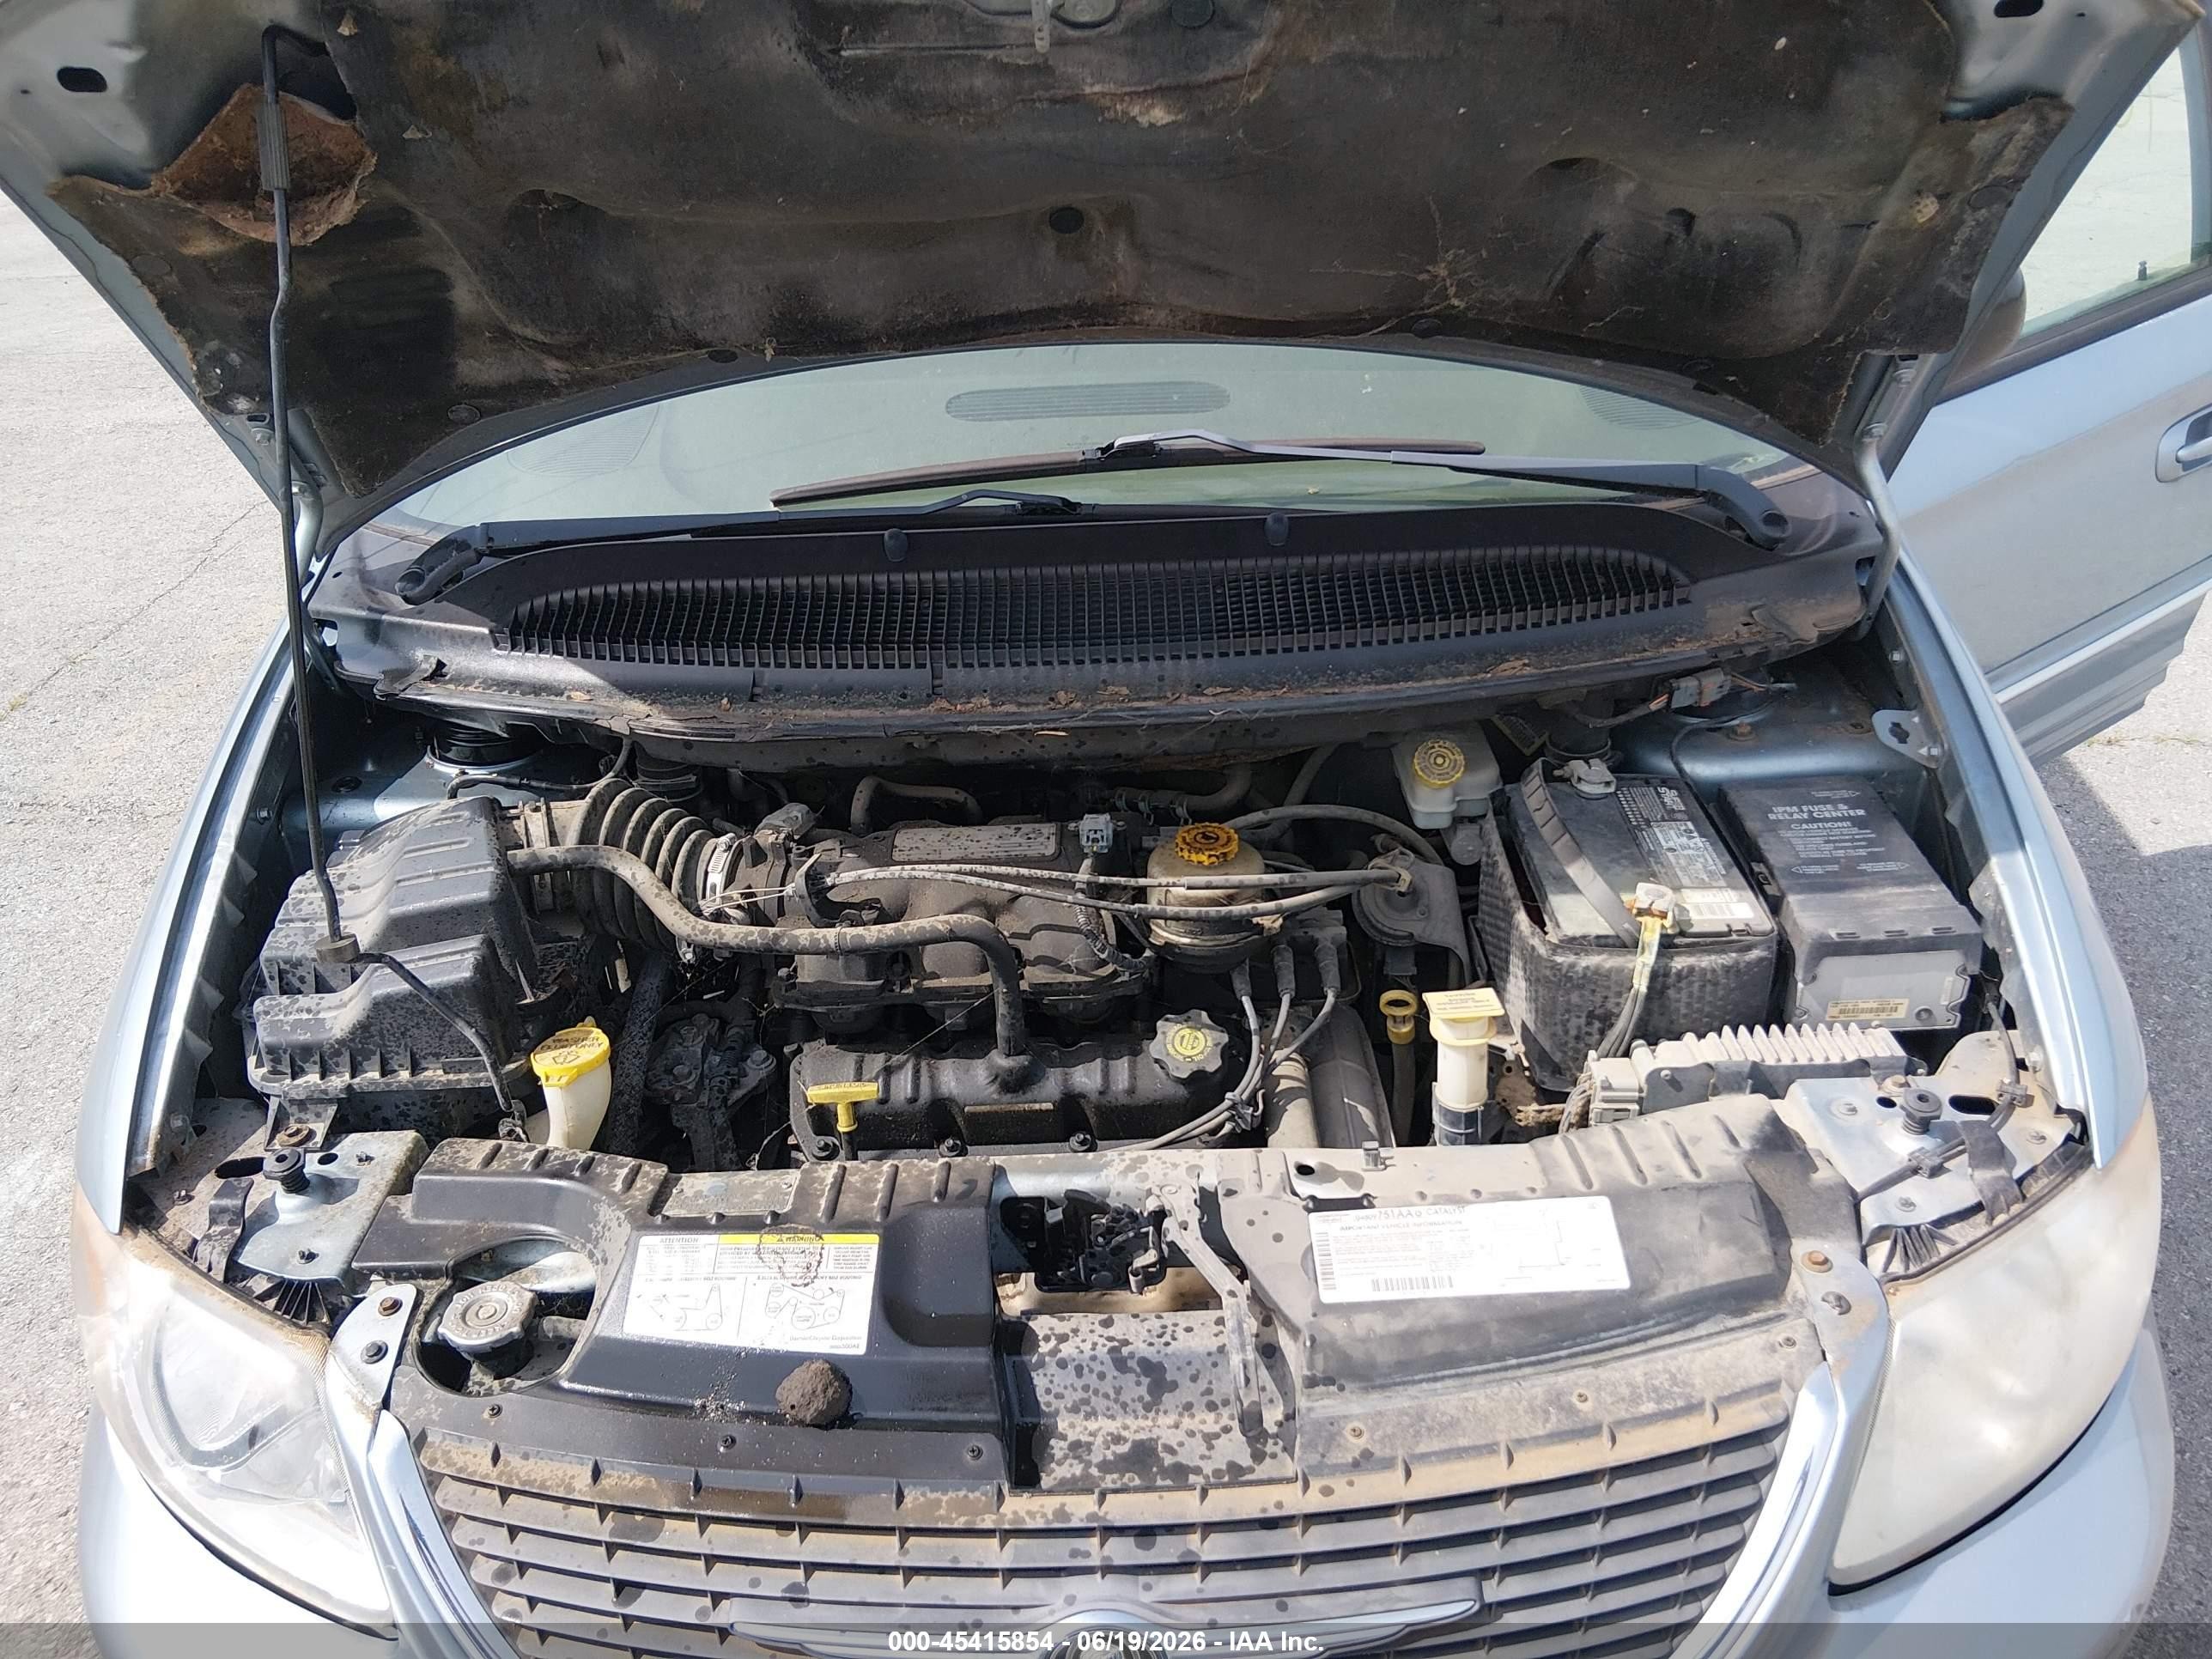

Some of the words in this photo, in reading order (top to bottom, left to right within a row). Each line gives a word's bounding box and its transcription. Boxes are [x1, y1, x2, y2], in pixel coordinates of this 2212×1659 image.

[1801, 804, 1835, 812] FUSE
[1813, 809, 1866, 818] CENTER
[1790, 821, 1852, 830] CAUTION!
[1426, 1206, 1465, 1216] CATALYST
